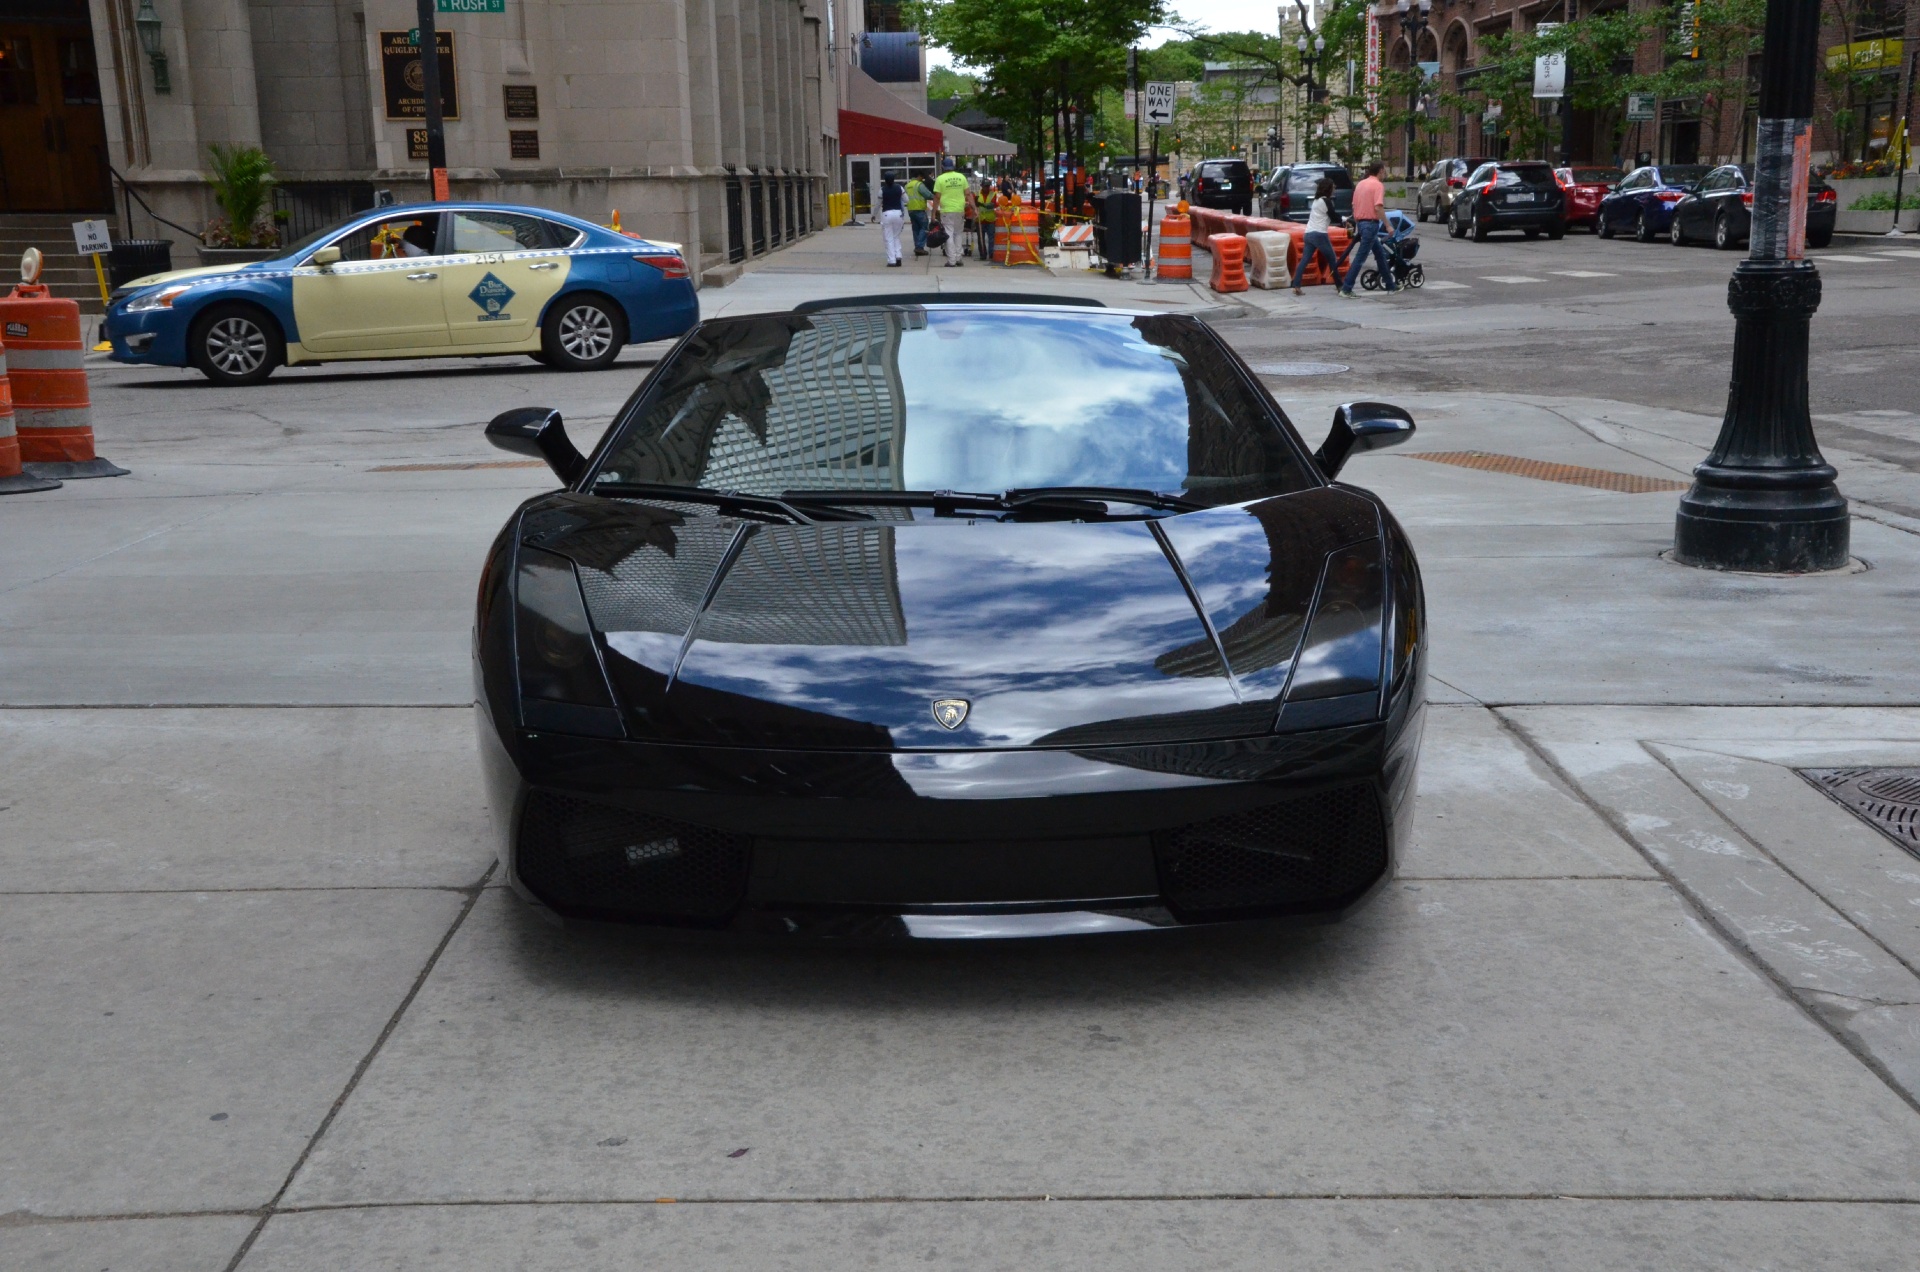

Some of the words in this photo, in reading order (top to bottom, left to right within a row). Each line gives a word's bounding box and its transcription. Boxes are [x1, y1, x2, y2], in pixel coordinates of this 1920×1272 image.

[451, 0, 487, 11] RUSH
[491, 0, 500, 8] ST
[384, 46, 418, 55] QUIGLEY
[1150, 86, 1171, 96] ONE
[1148, 97, 1170, 107] WAY
[413, 131, 428, 143] 83
[81, 242, 108, 251] PARKING
[475, 254, 505, 264] 2154
